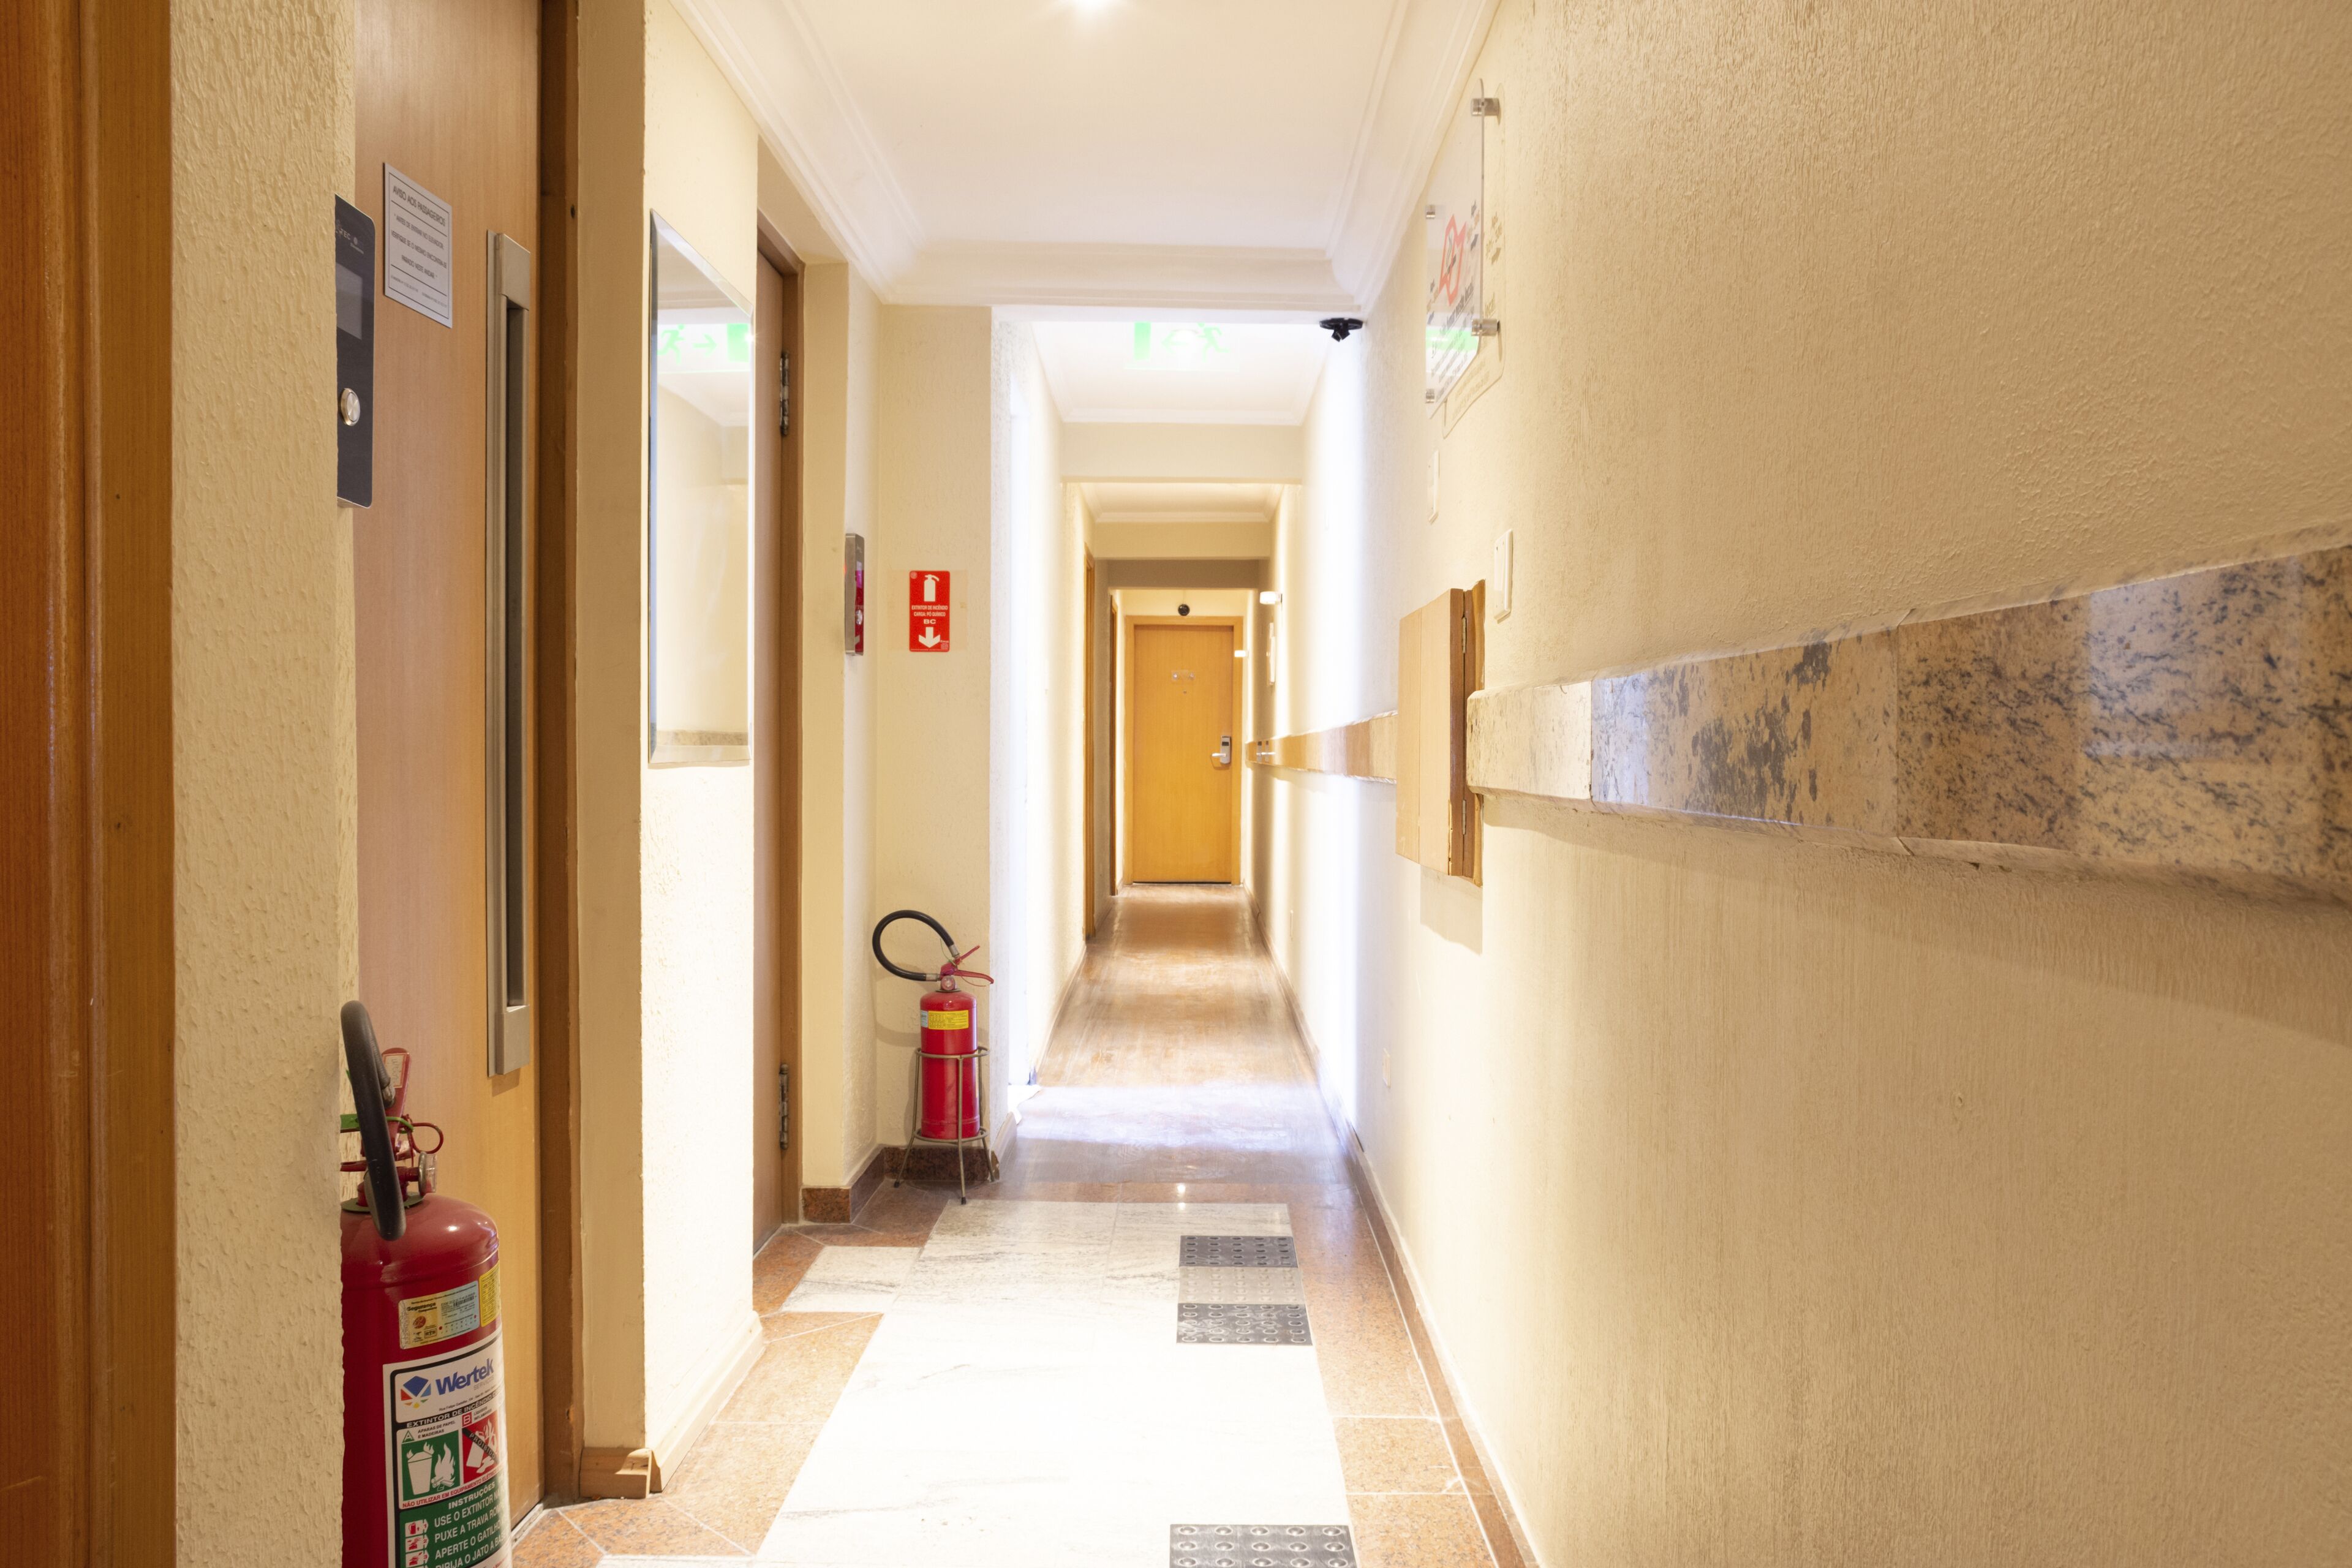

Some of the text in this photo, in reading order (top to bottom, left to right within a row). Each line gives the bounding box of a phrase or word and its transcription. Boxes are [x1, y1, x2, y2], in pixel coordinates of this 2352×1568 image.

[393, 186, 446, 227] AVISO AOS PASSAGEIROS
[435, 1358, 494, 1395] Wertek
[407, 1414, 450, 1428] EXTINTOR
[452, 1409, 463, 1417] DE
[464, 1394, 492, 1412] INCÊNDIO
[463, 1415, 471, 1425] B
[421, 1429, 444, 1438] MADEIRAS
[469, 1433, 496, 1459] PROIBIDO
[416, 1495, 441, 1506] UTILIZAR
[450, 1479, 482, 1496] EQUIPAMENTO
[448, 1481, 496, 1509] INSTRUÇÕES
[434, 1513, 451, 1528] USE
[454, 1511, 460, 1521] O
[462, 1496, 493, 1518] EXTINTOR
[434, 1527, 458, 1543] PUXE
[460, 1525, 466, 1535] A
[467, 1513, 489, 1531] TRAVA
[435, 1540, 469, 1560] APERTE
[470, 1537, 476, 1546] O
[477, 1520, 501, 1541] GATILHO
[464, 1555, 470, 1564] O
[472, 1544, 489, 1561] JATO
[490, 1539, 495, 1549] A
